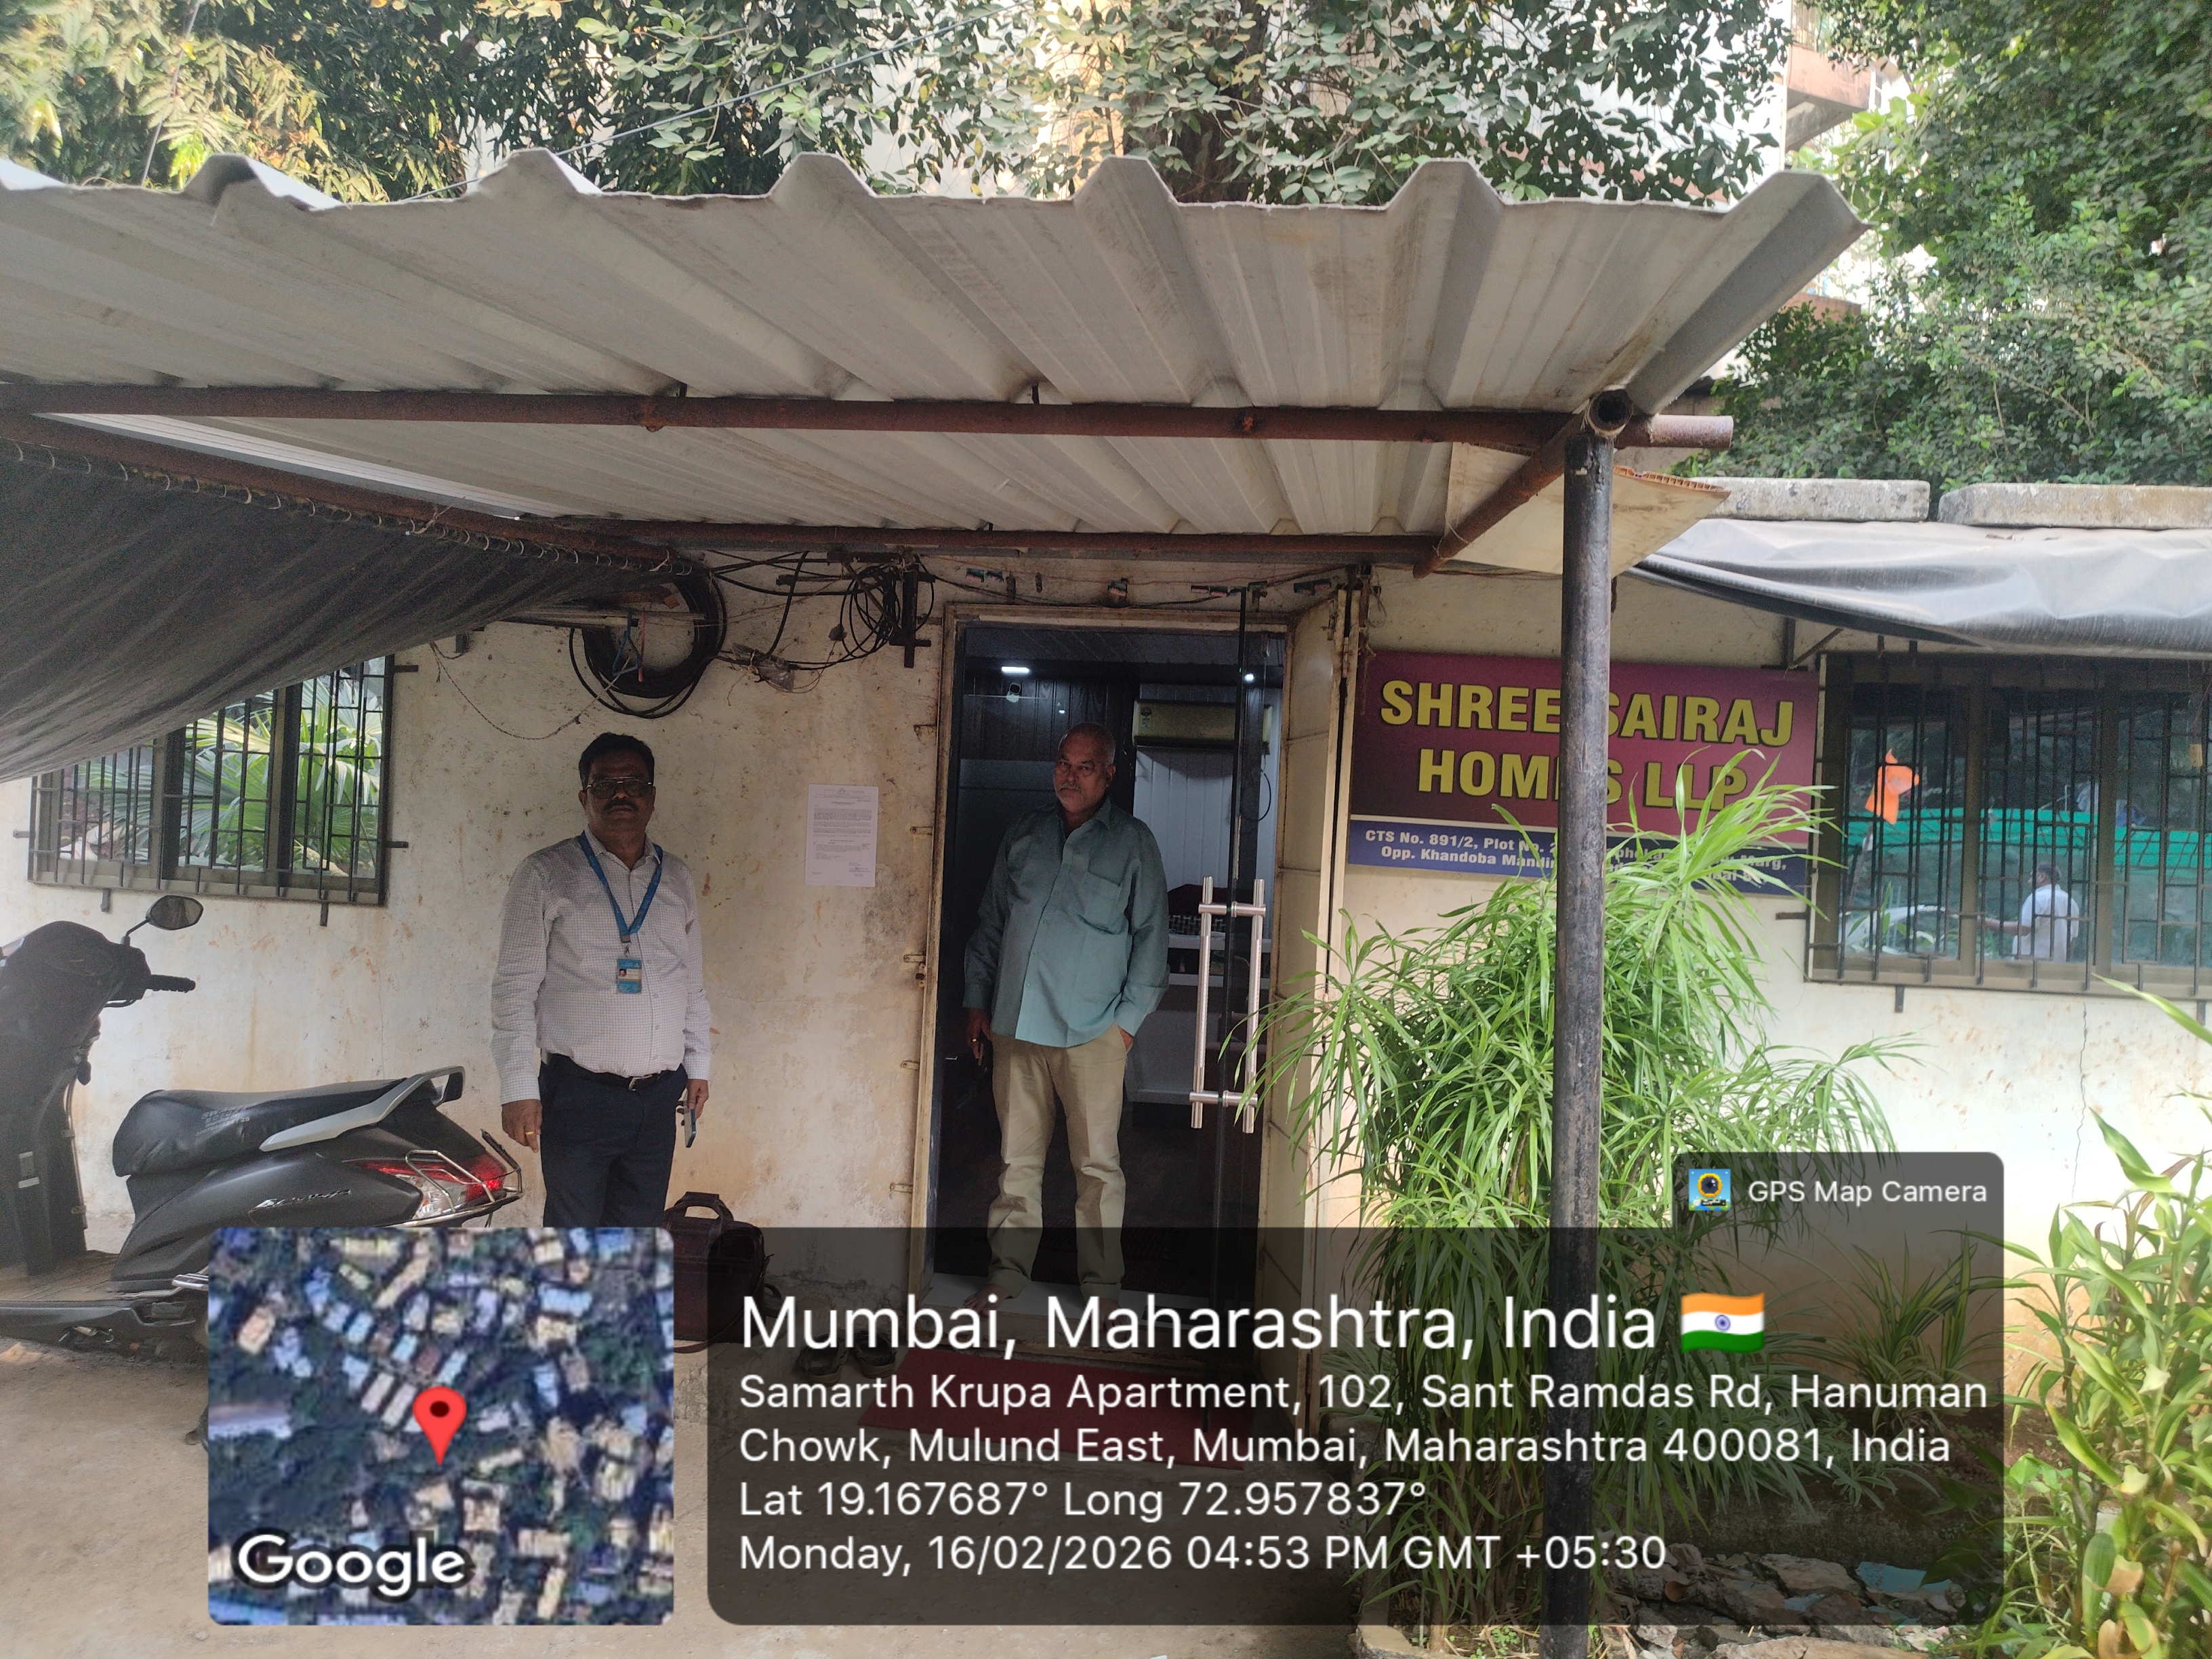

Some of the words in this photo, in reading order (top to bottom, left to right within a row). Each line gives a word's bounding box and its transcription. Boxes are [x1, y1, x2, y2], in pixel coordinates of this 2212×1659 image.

[1380, 680, 1560, 733] SHREE
[1418, 748, 1622, 804] HOMS
[1644, 761, 1748, 812] LLP
[1365, 830, 1395, 843] CTS
[1399, 832, 1424, 845] No.
[1429, 833, 1479, 850] 891/2,
[1483, 837, 1515, 851] Plot
[1519, 840, 1544, 853] No.
[1381, 845, 1416, 861] Opp.
[1420, 848, 1497, 865] Khandoba
